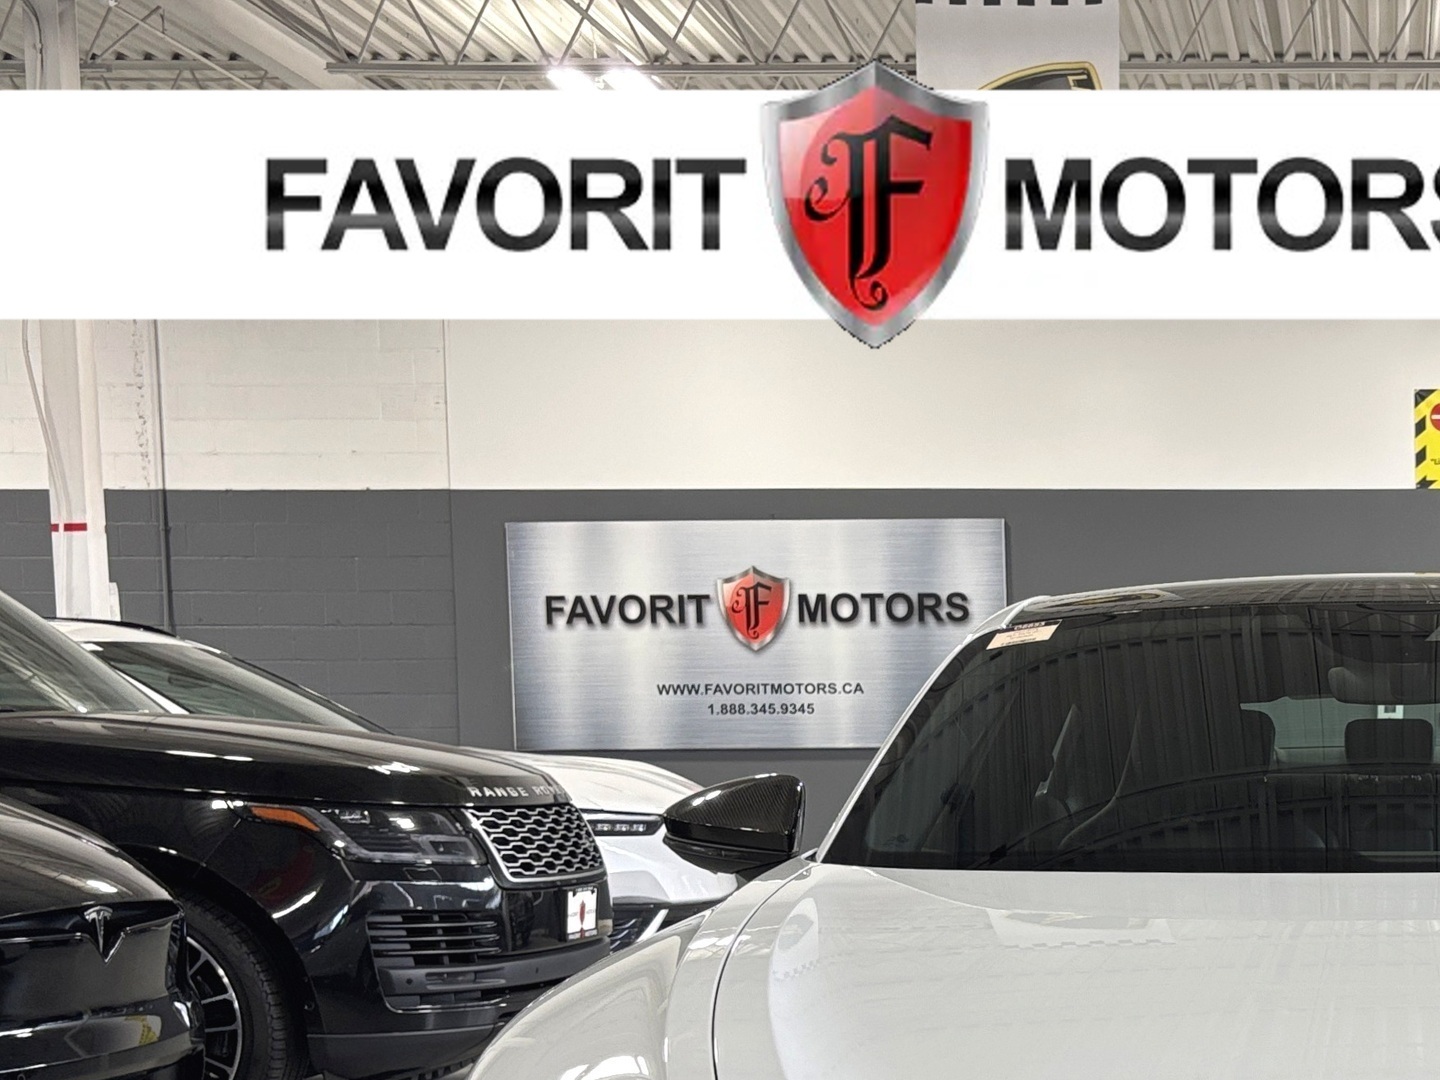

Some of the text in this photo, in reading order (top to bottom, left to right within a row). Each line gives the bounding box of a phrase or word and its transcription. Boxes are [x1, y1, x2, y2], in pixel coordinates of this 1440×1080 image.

[545, 595, 711, 627] FAVORIT
[797, 593, 970, 626] MOTORS
[656, 682, 865, 696] WWW.FAVORITMOTORS.CA
[707, 703, 816, 716] 1.888.345.9345
[467, 786, 529, 797] RANGE
